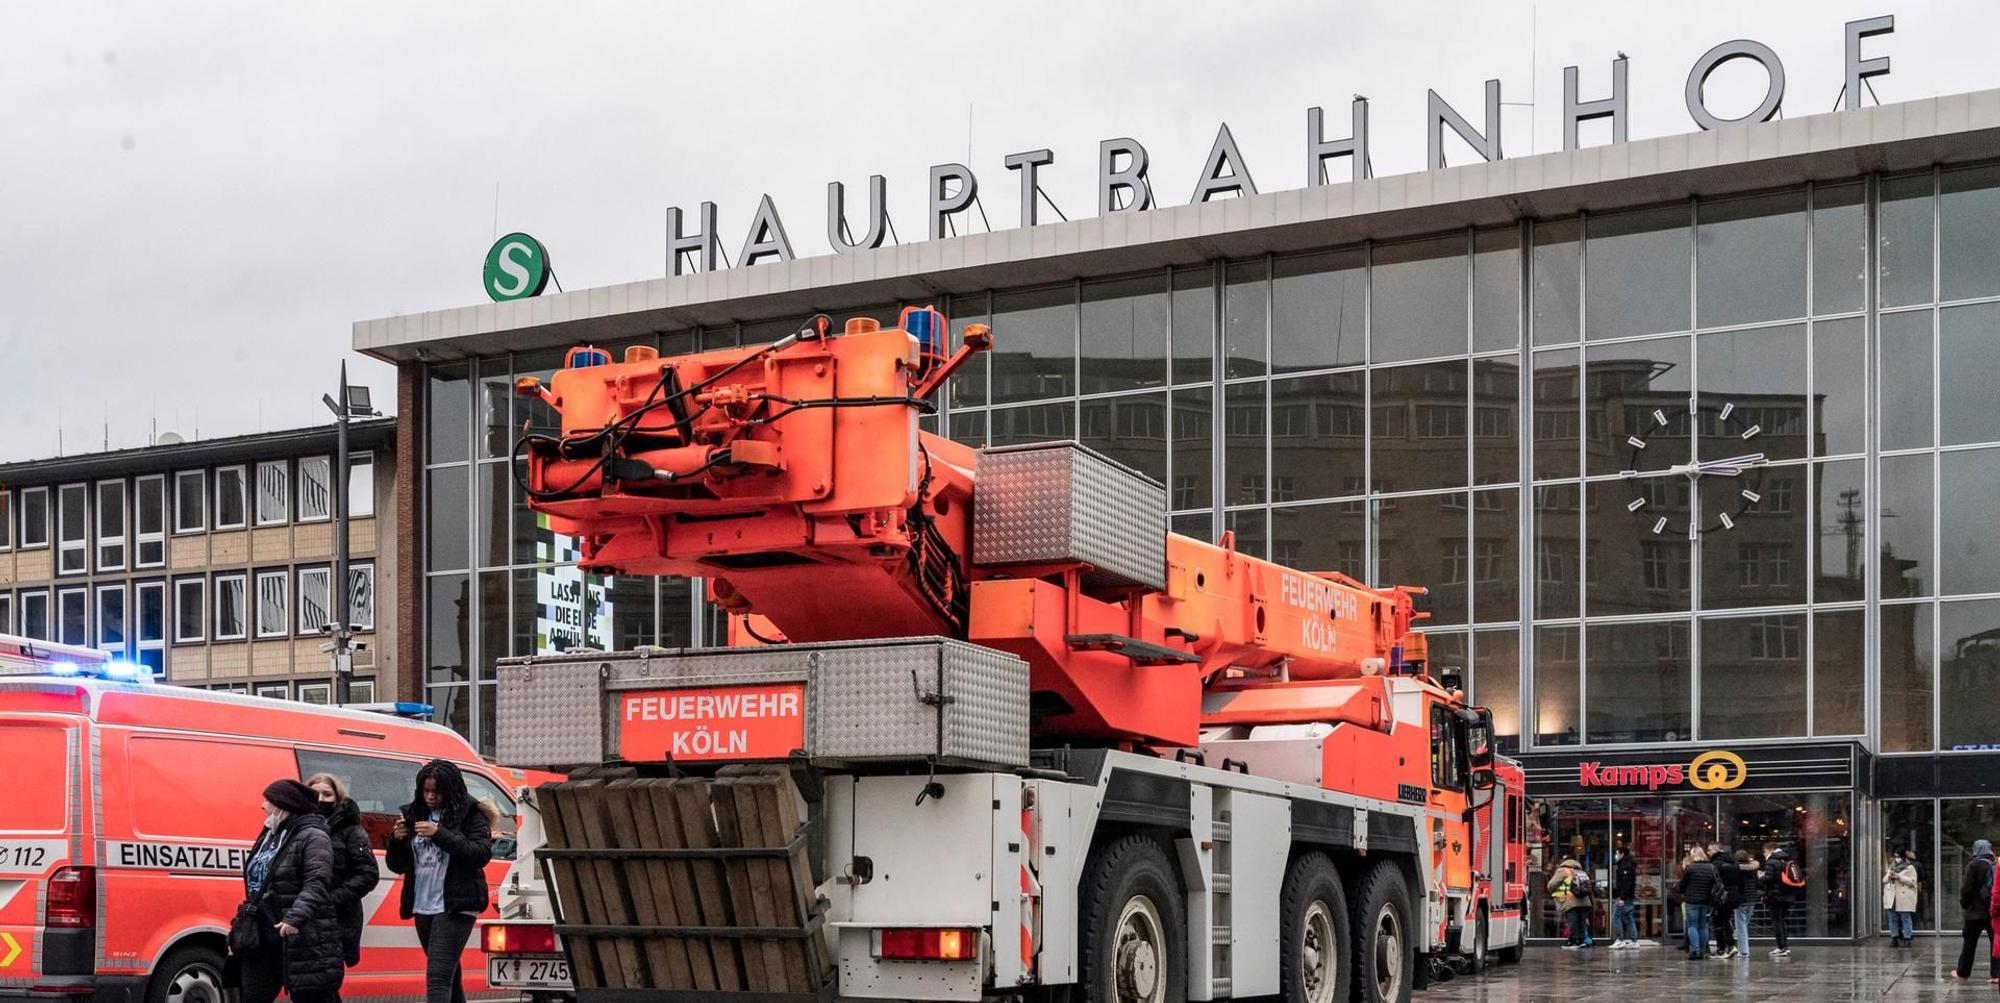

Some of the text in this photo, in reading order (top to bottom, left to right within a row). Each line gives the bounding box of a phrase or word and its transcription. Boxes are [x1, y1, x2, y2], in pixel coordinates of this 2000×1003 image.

[667, 14, 1895, 277] HAUPTBAHNHOF
[494, 242, 532, 296] S
[1281, 573, 1358, 621] FEUERWEHR
[555, 605, 597, 630] DIE EDE
[1302, 614, 1337, 653] KÖLN
[626, 692, 799, 721] FEUERWEHR
[672, 725, 748, 755] KÖLN
[1579, 761, 1684, 790] Kamps
[15, 847, 46, 866] 112
[497, 962, 508, 980] K
